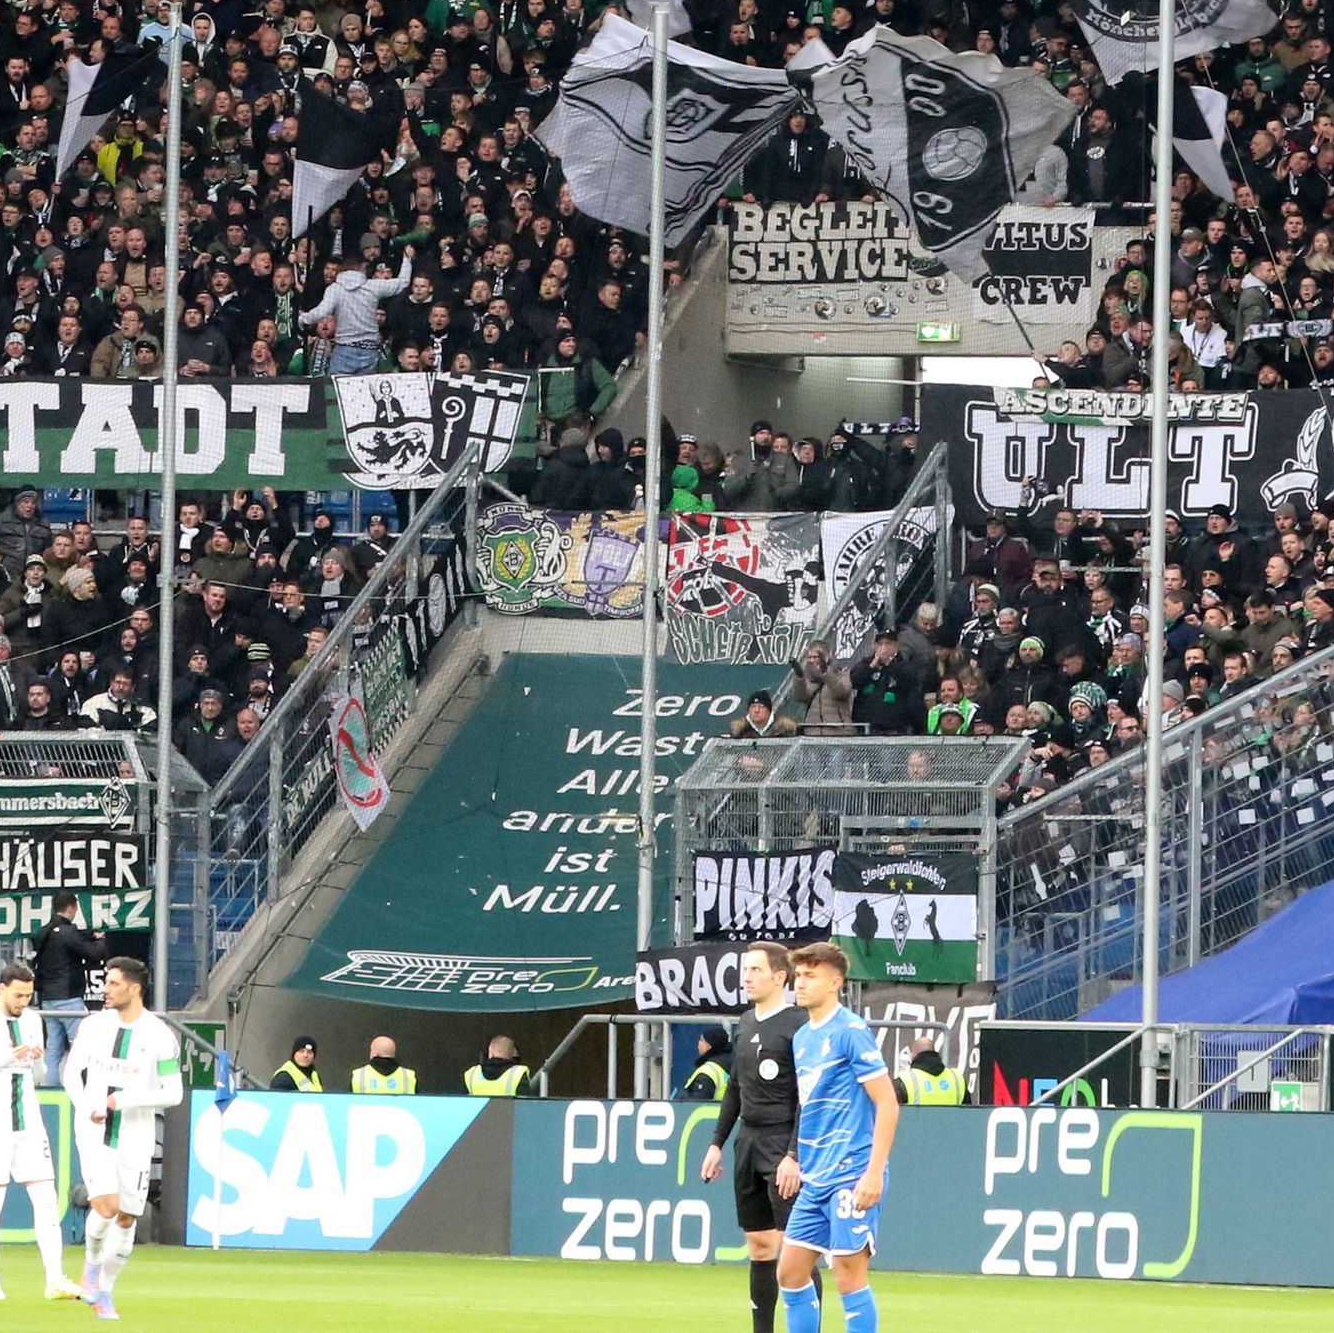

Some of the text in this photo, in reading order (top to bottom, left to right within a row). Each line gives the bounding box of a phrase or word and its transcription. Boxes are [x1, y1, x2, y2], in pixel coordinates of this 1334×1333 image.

[730, 240, 909, 282] SERVICE
[980, 276, 1084, 306] CREW
[834, 526, 880, 587] JAHRE
[612, 689, 742, 717] Zero
[544, 846, 619, 874] ist
[861, 860, 947, 891] Steigerwaldfohlen
[483, 884, 622, 914] Müll.
[468, 968, 538, 985] pre
[886, 962, 917, 975] Fanclub
[460, 980, 555, 995] zero
[563, 1100, 676, 1184] pre
[984, 1106, 1100, 1196] pre
[190, 1098, 427, 1238] SAP
[561, 1197, 710, 1263] zero
[981, 1209, 1139, 1280] zero
